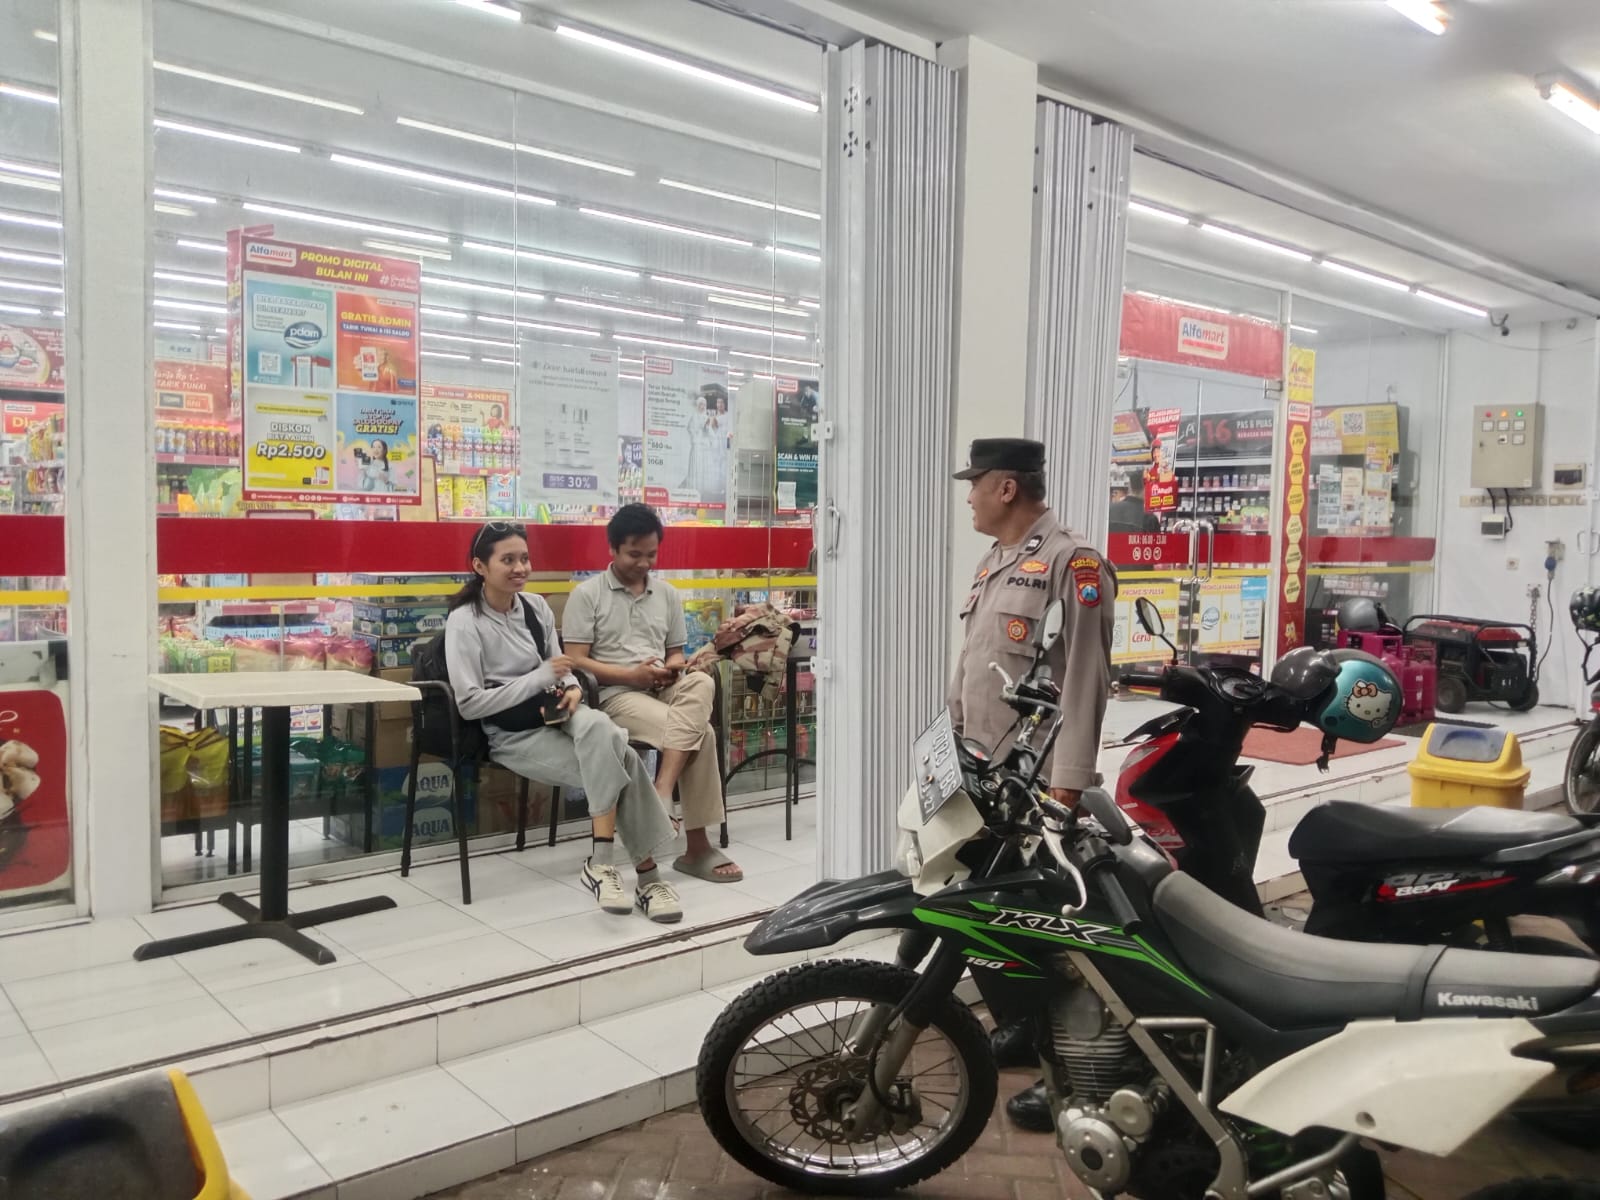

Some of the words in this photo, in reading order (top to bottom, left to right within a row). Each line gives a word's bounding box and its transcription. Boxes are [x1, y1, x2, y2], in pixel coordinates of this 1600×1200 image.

[249, 244, 293, 259] Alfamart
[300, 251, 341, 266] PROMO
[343, 257, 383, 272] DIGITAL
[316, 266, 351, 281] BULAN
[354, 272, 369, 283] INI
[341, 311, 377, 324] GRATIS
[379, 316, 412, 328] ADMIN
[289, 327, 319, 338] pdam
[1182, 322, 1224, 344] Alfamart
[271, 422, 311, 433] DISKON
[355, 424, 399, 434] GRATIS!
[1202, 418, 1232, 447] 16
[257, 442, 325, 460] Rp2.500
[778, 452, 793, 460] SCAN
[567, 476, 591, 488] 30%
[1007, 577, 1047, 590] POLRI
[423, 618, 443, 627] AQUA
[412, 819, 449, 837] AQUA
[1395, 879, 1460, 897] BeAT
[988, 909, 1113, 945] KLX
[966, 956, 1006, 969] 150
[1437, 992, 1539, 1011] Kawasaki
